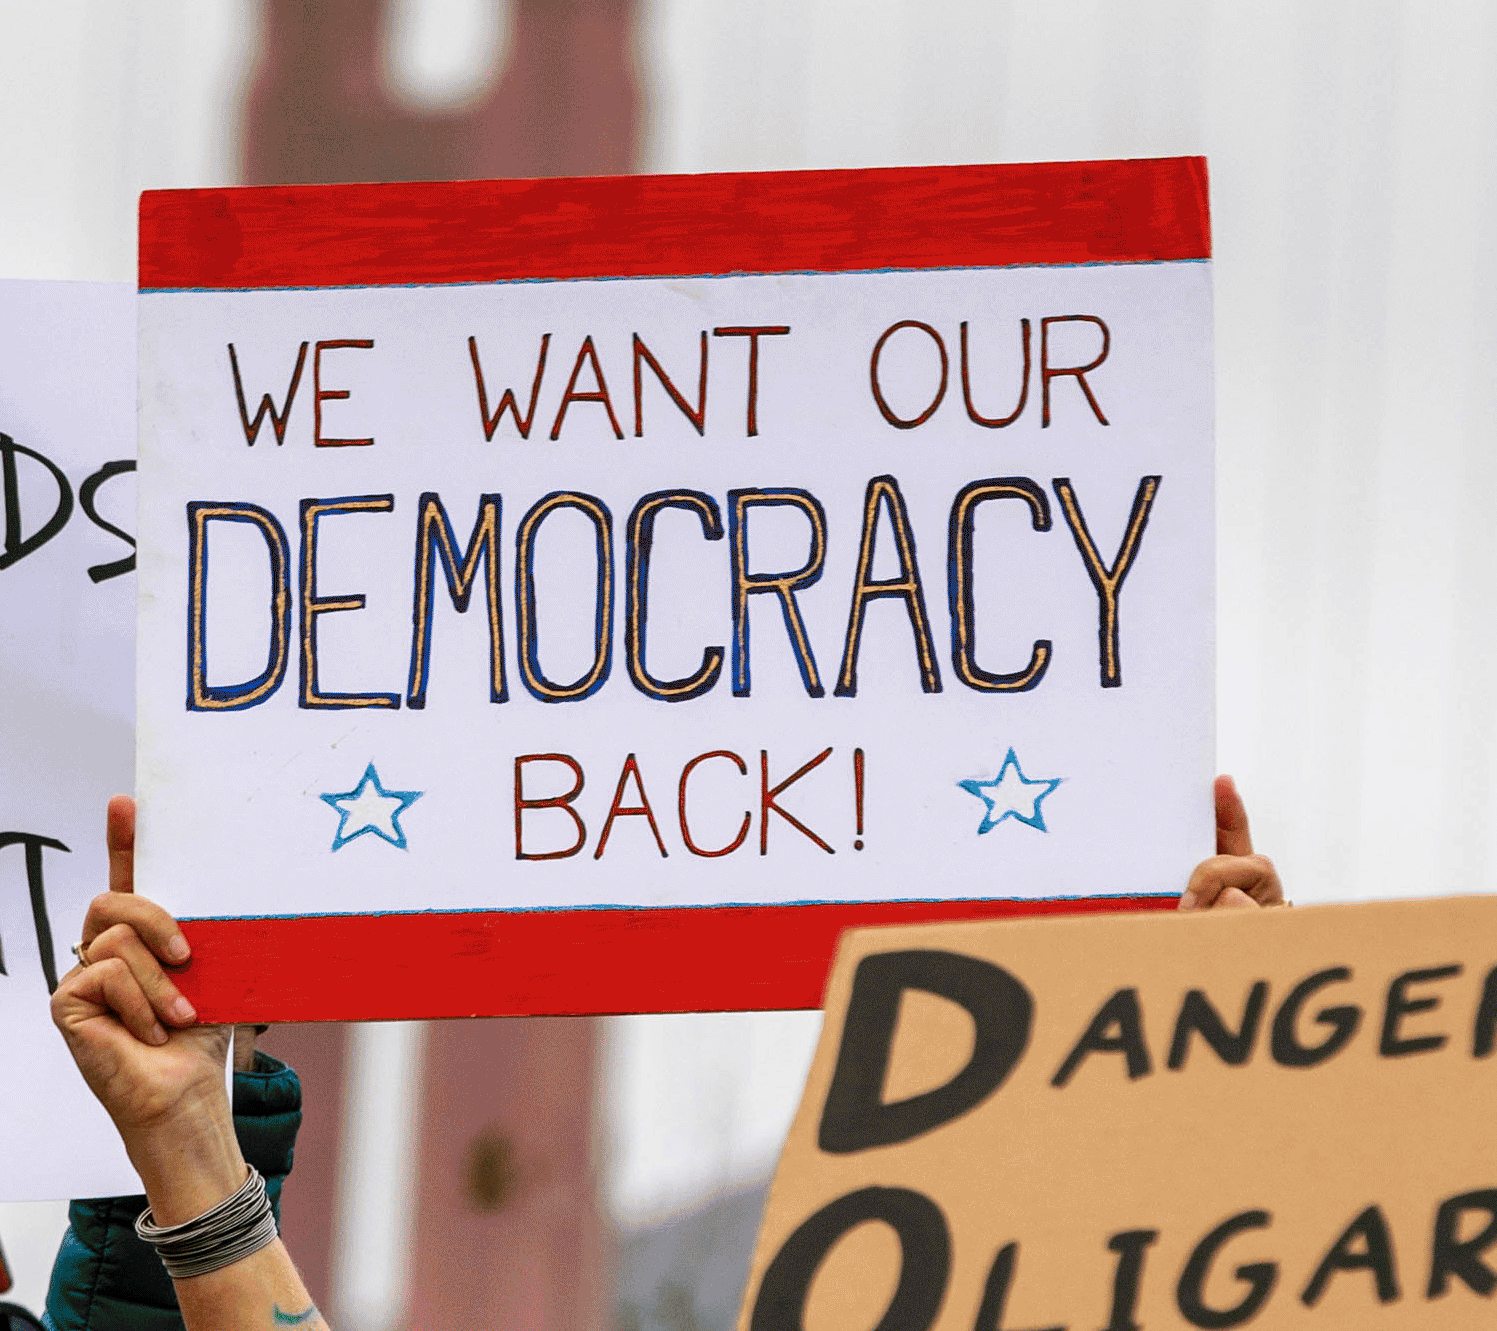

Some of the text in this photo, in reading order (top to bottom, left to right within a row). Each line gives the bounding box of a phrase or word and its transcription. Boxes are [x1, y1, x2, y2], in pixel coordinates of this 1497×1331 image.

[227, 315, 1110, 448] WE WANT OUR
[186, 474, 1162, 712] DEMOCRACY
[514, 747, 864, 861] BACK!
